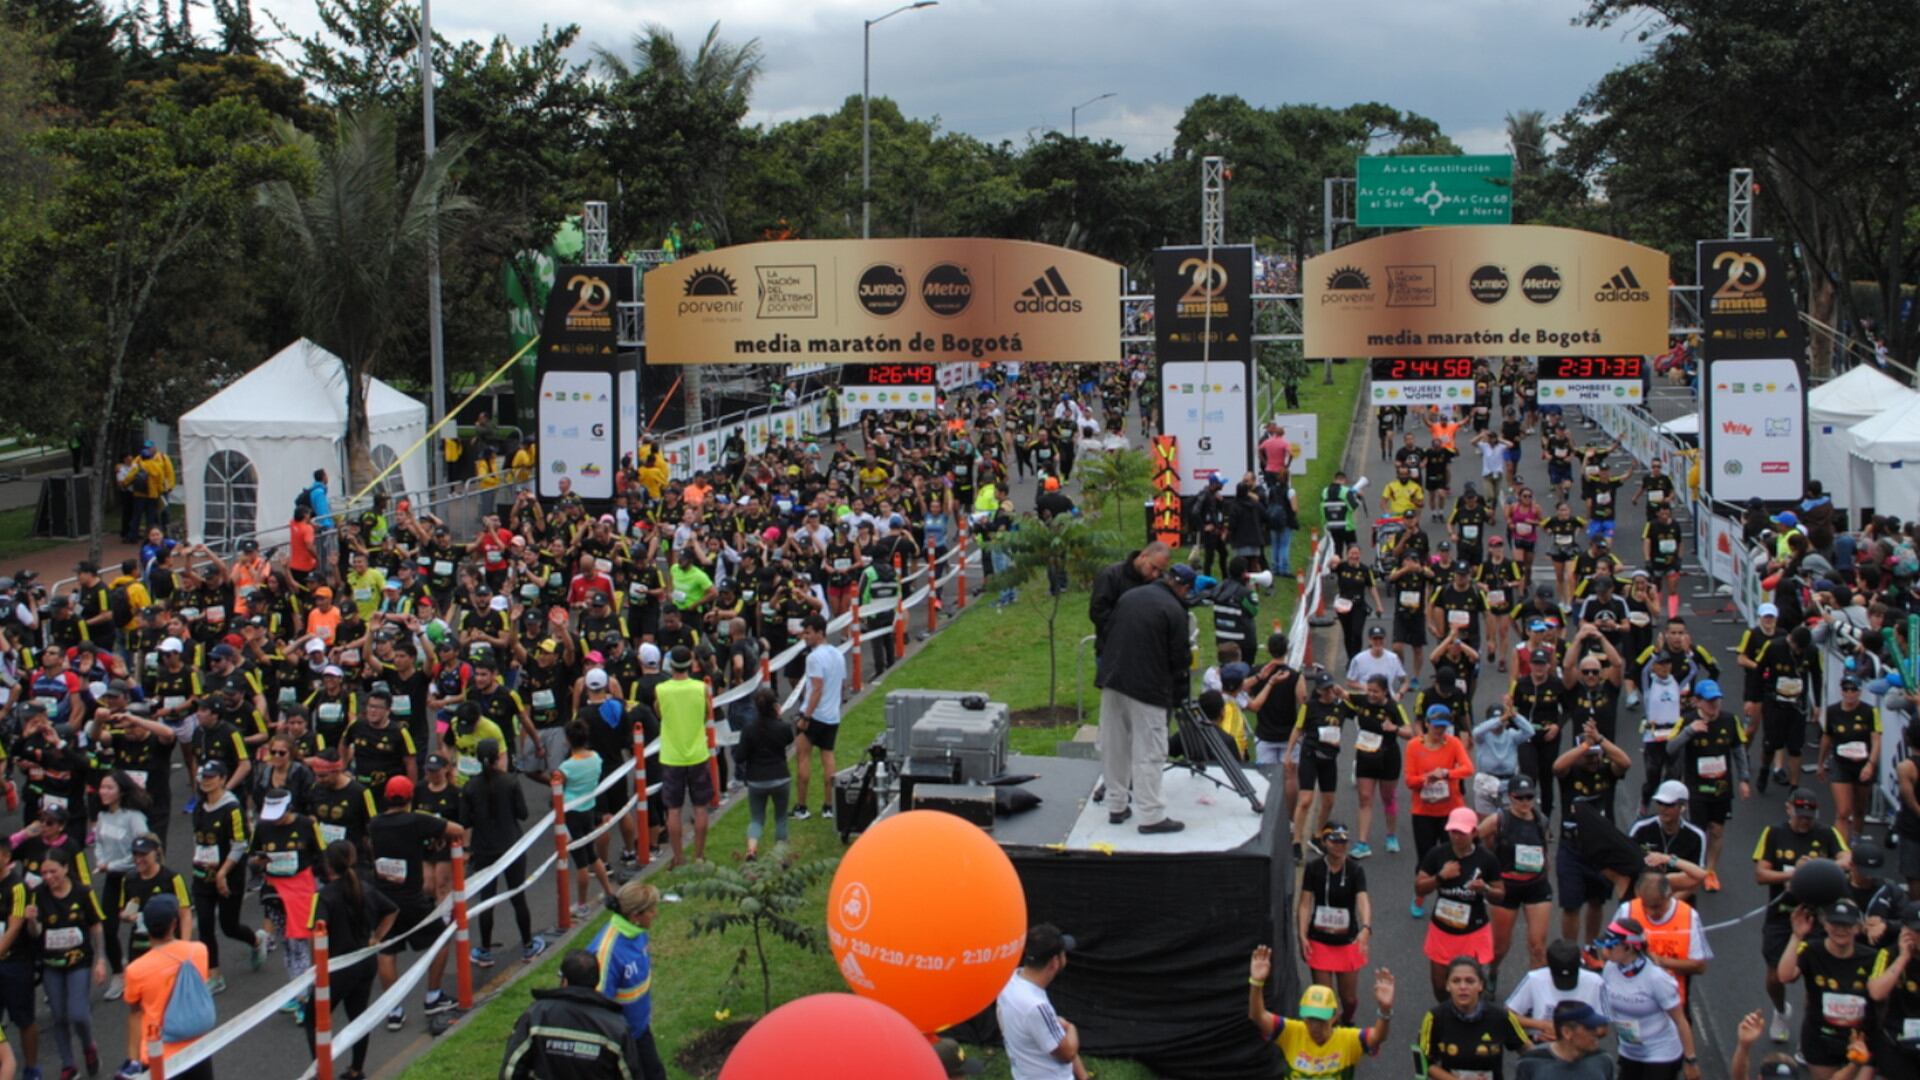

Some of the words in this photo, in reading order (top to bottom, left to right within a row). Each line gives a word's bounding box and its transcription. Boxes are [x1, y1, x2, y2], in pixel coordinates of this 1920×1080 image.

[1383, 164, 1397, 173] Av
[1401, 164, 1415, 173] La
[1419, 163, 1491, 173] Constitución
[1360, 187, 1373, 196] Av
[1377, 187, 1397, 196] Cra
[1384, 199, 1404, 208] Sur
[1452, 195, 1467, 204] Av
[1471, 195, 1489, 204] Cra
[1473, 207, 1503, 216] Norte
[1712, 251, 1767, 298] 20
[860, 284, 905, 296] JUMBO
[923, 283, 970, 296] Metro
[1471, 279, 1508, 289] JUMBO
[1522, 278, 1561, 289] Metro
[567, 274, 611, 316] 20
[1321, 292, 1376, 305] porvenir
[1595, 288, 1649, 302] adidas
[678, 300, 745, 317] porvenir
[1014, 296, 1082, 313] adidas
[735, 333, 801, 353] media
[808, 333, 901, 352] maratón
[908, 331, 935, 352] de
[942, 332, 1023, 358] Bogotá
[1367, 329, 1422, 345] media
[1427, 329, 1503, 345] maratón
[1509, 328, 1531, 344] de
[1536, 328, 1602, 348] Bogotá
[1402, 384, 1442, 393] MUJERES
[1568, 383, 1612, 392] HOMBRES
[880, 946, 904, 966] 2:10
[915, 954, 944, 971] 2:10
[962, 947, 992, 965] 2:10
